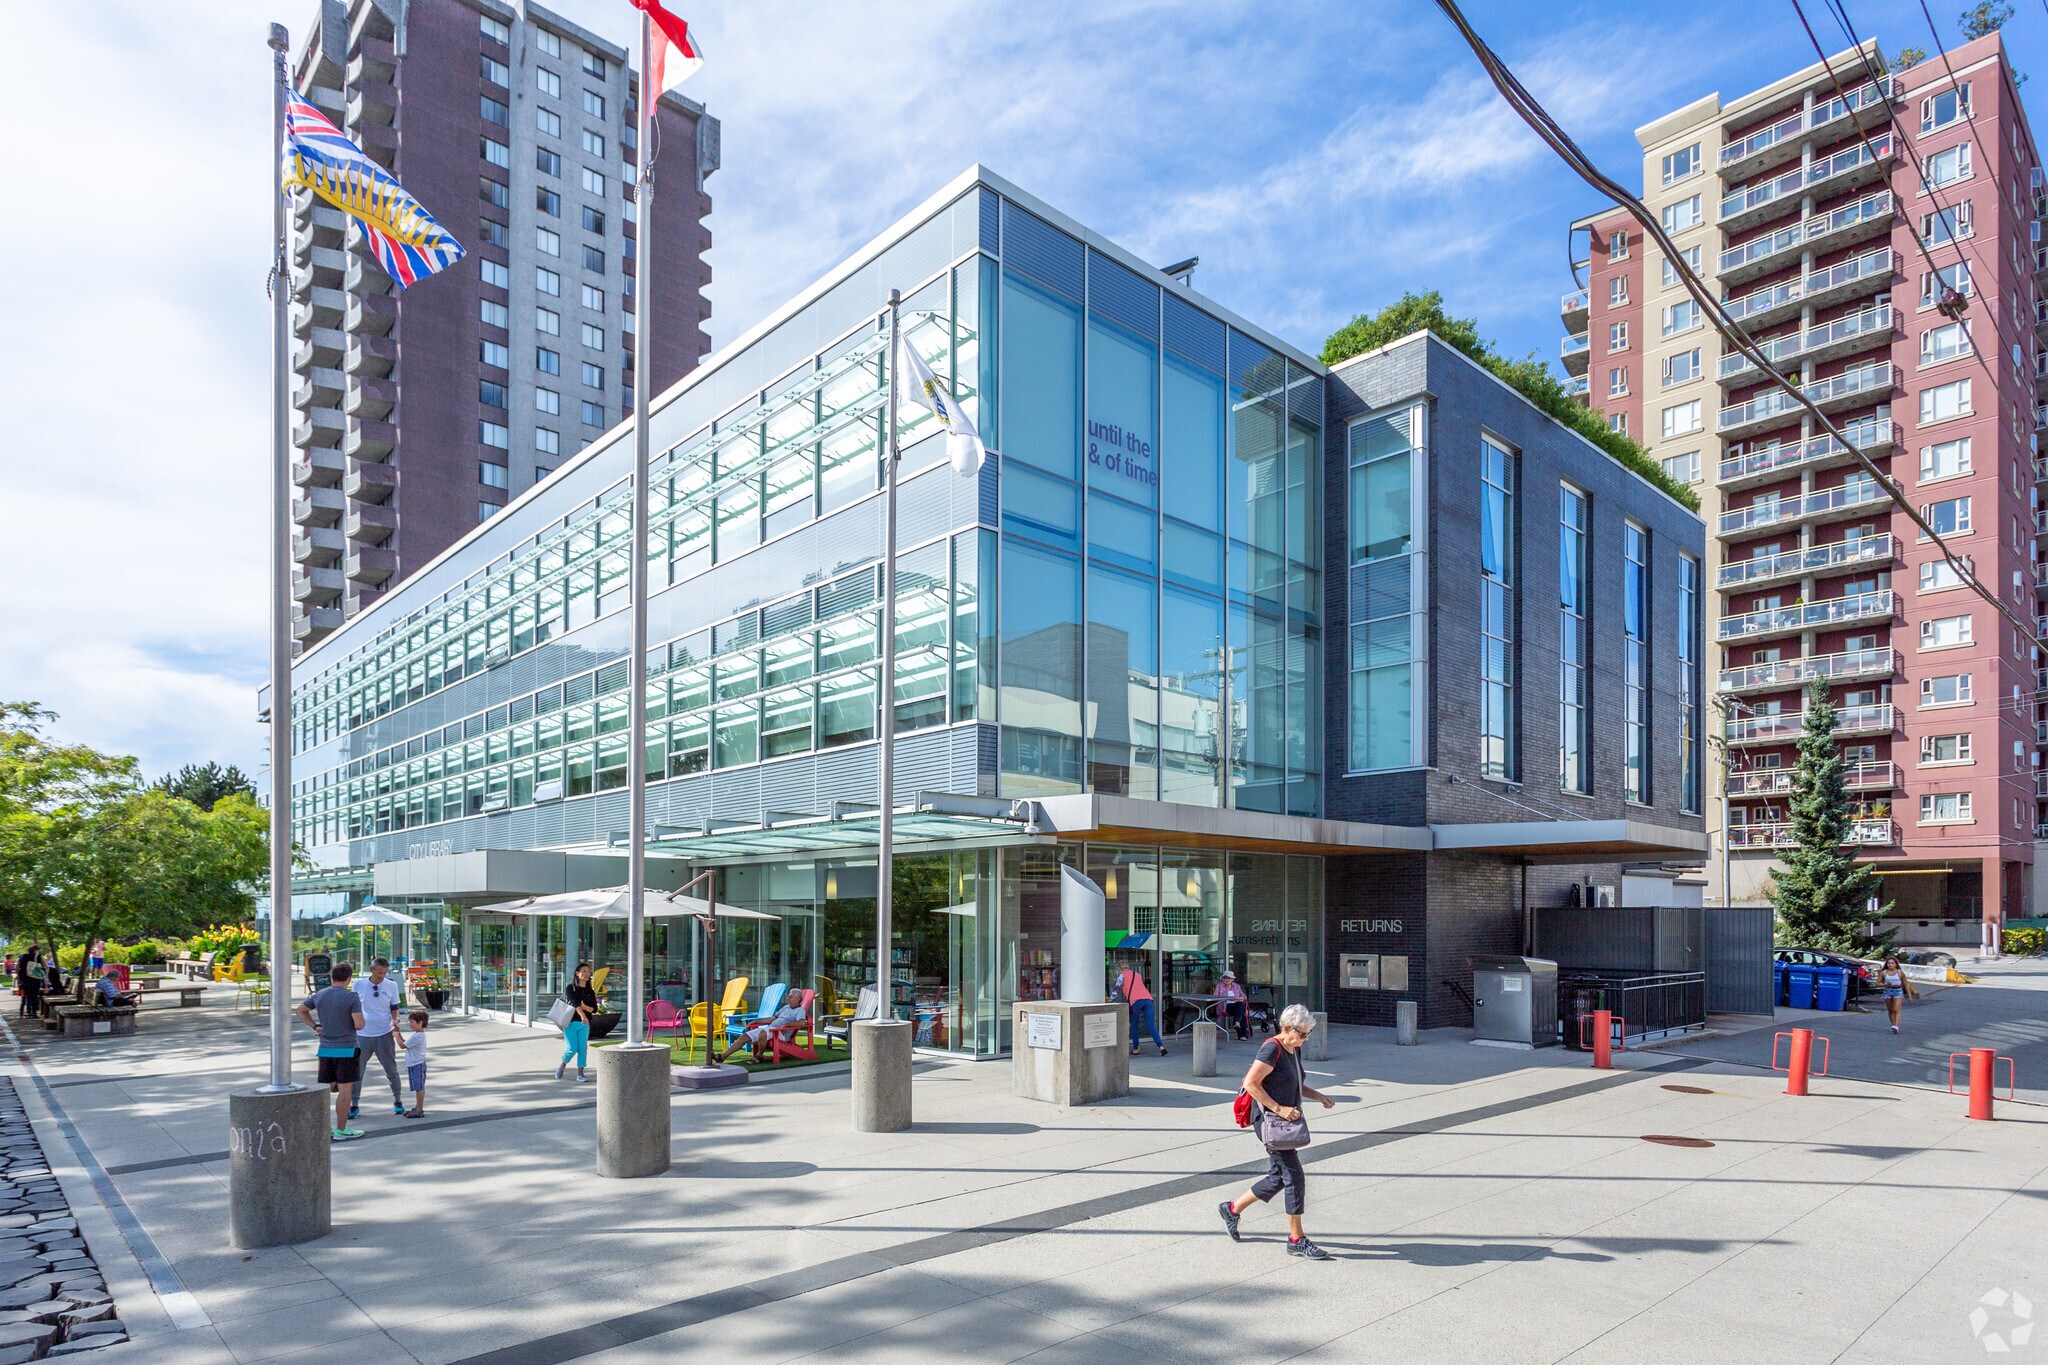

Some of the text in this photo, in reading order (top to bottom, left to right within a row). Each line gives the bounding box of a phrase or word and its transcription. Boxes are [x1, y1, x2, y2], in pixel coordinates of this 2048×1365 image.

[1088, 419, 1151, 458] until the
[1088, 442, 1157, 487] & of time
[425, 838, 454, 858] LIBRARY
[1340, 919, 1403, 933] RETURNS
